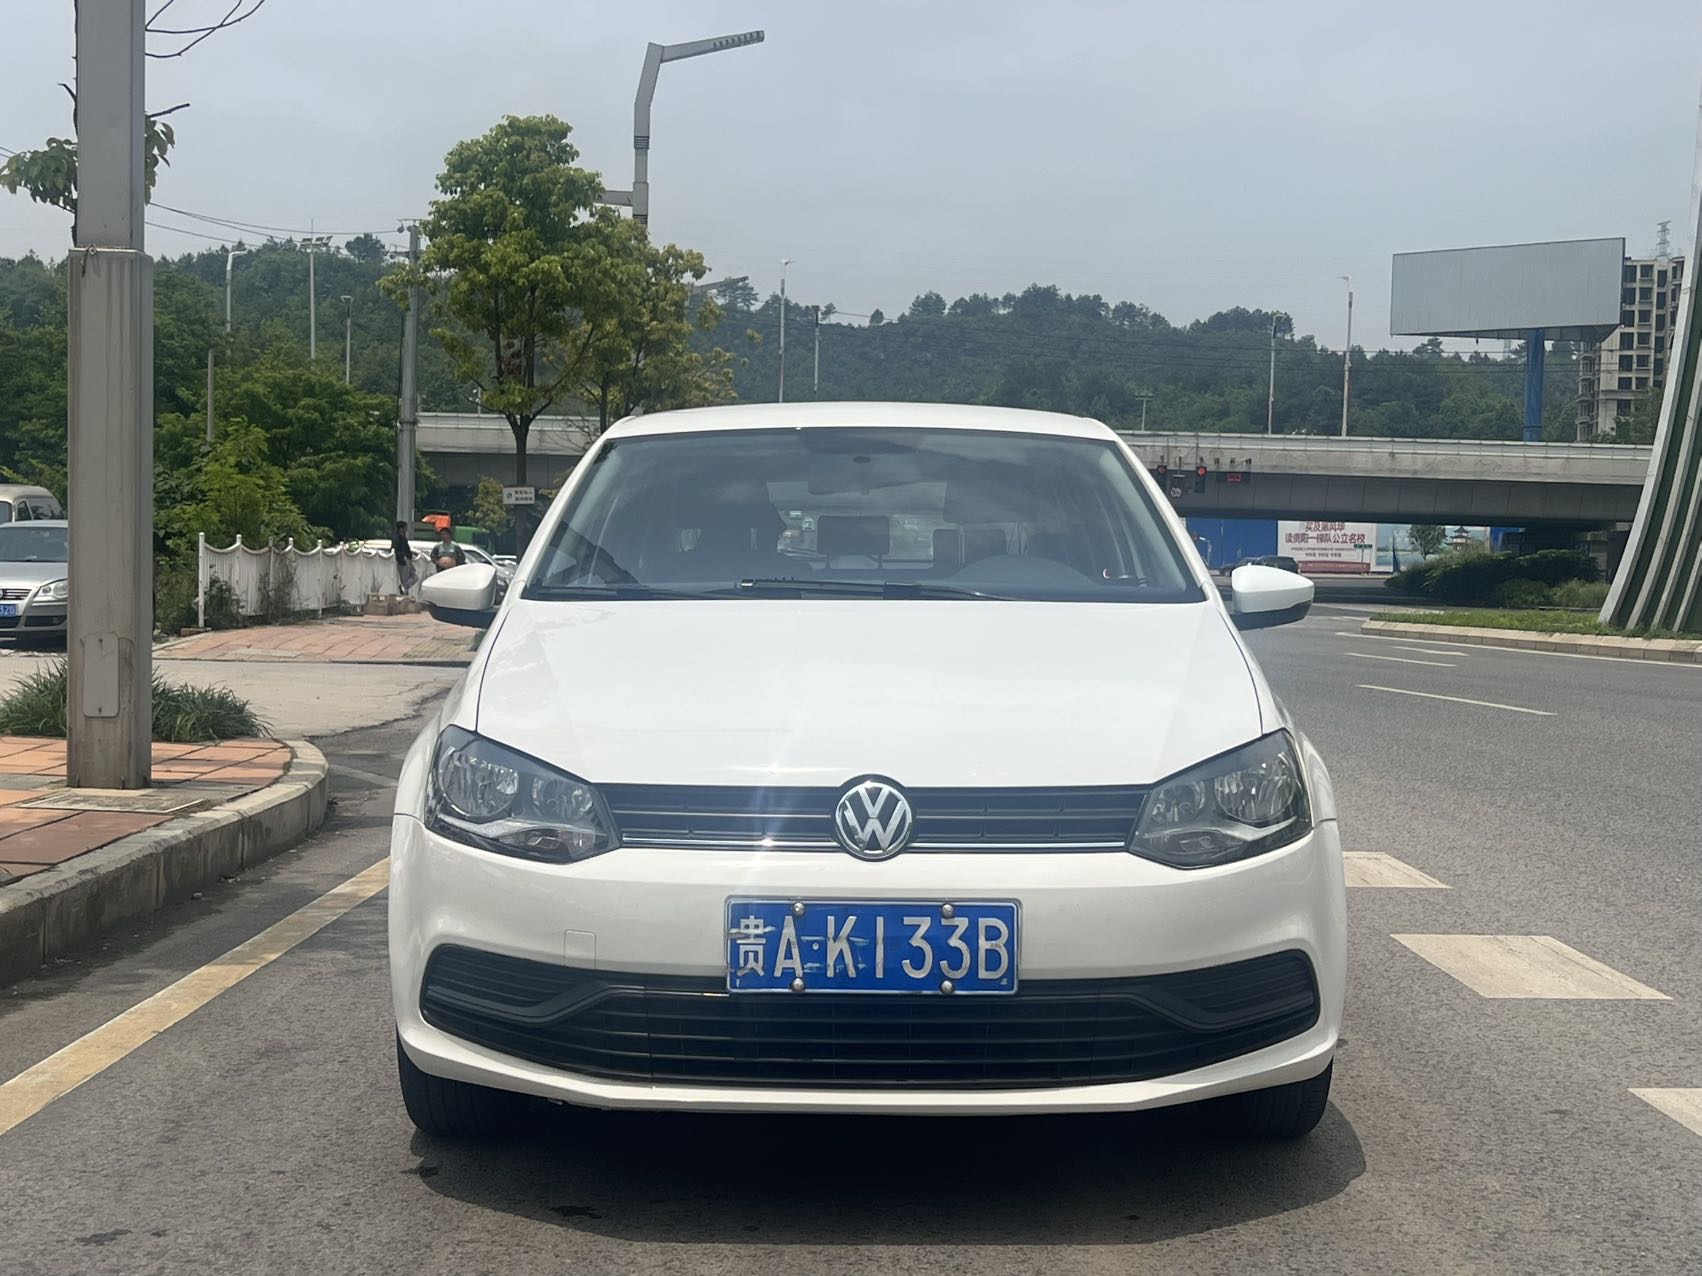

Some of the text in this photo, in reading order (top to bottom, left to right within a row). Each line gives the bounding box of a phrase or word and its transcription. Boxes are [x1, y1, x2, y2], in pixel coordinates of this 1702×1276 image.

[1285, 533, 1366, 544] 读贵阳一梯队公立名校
